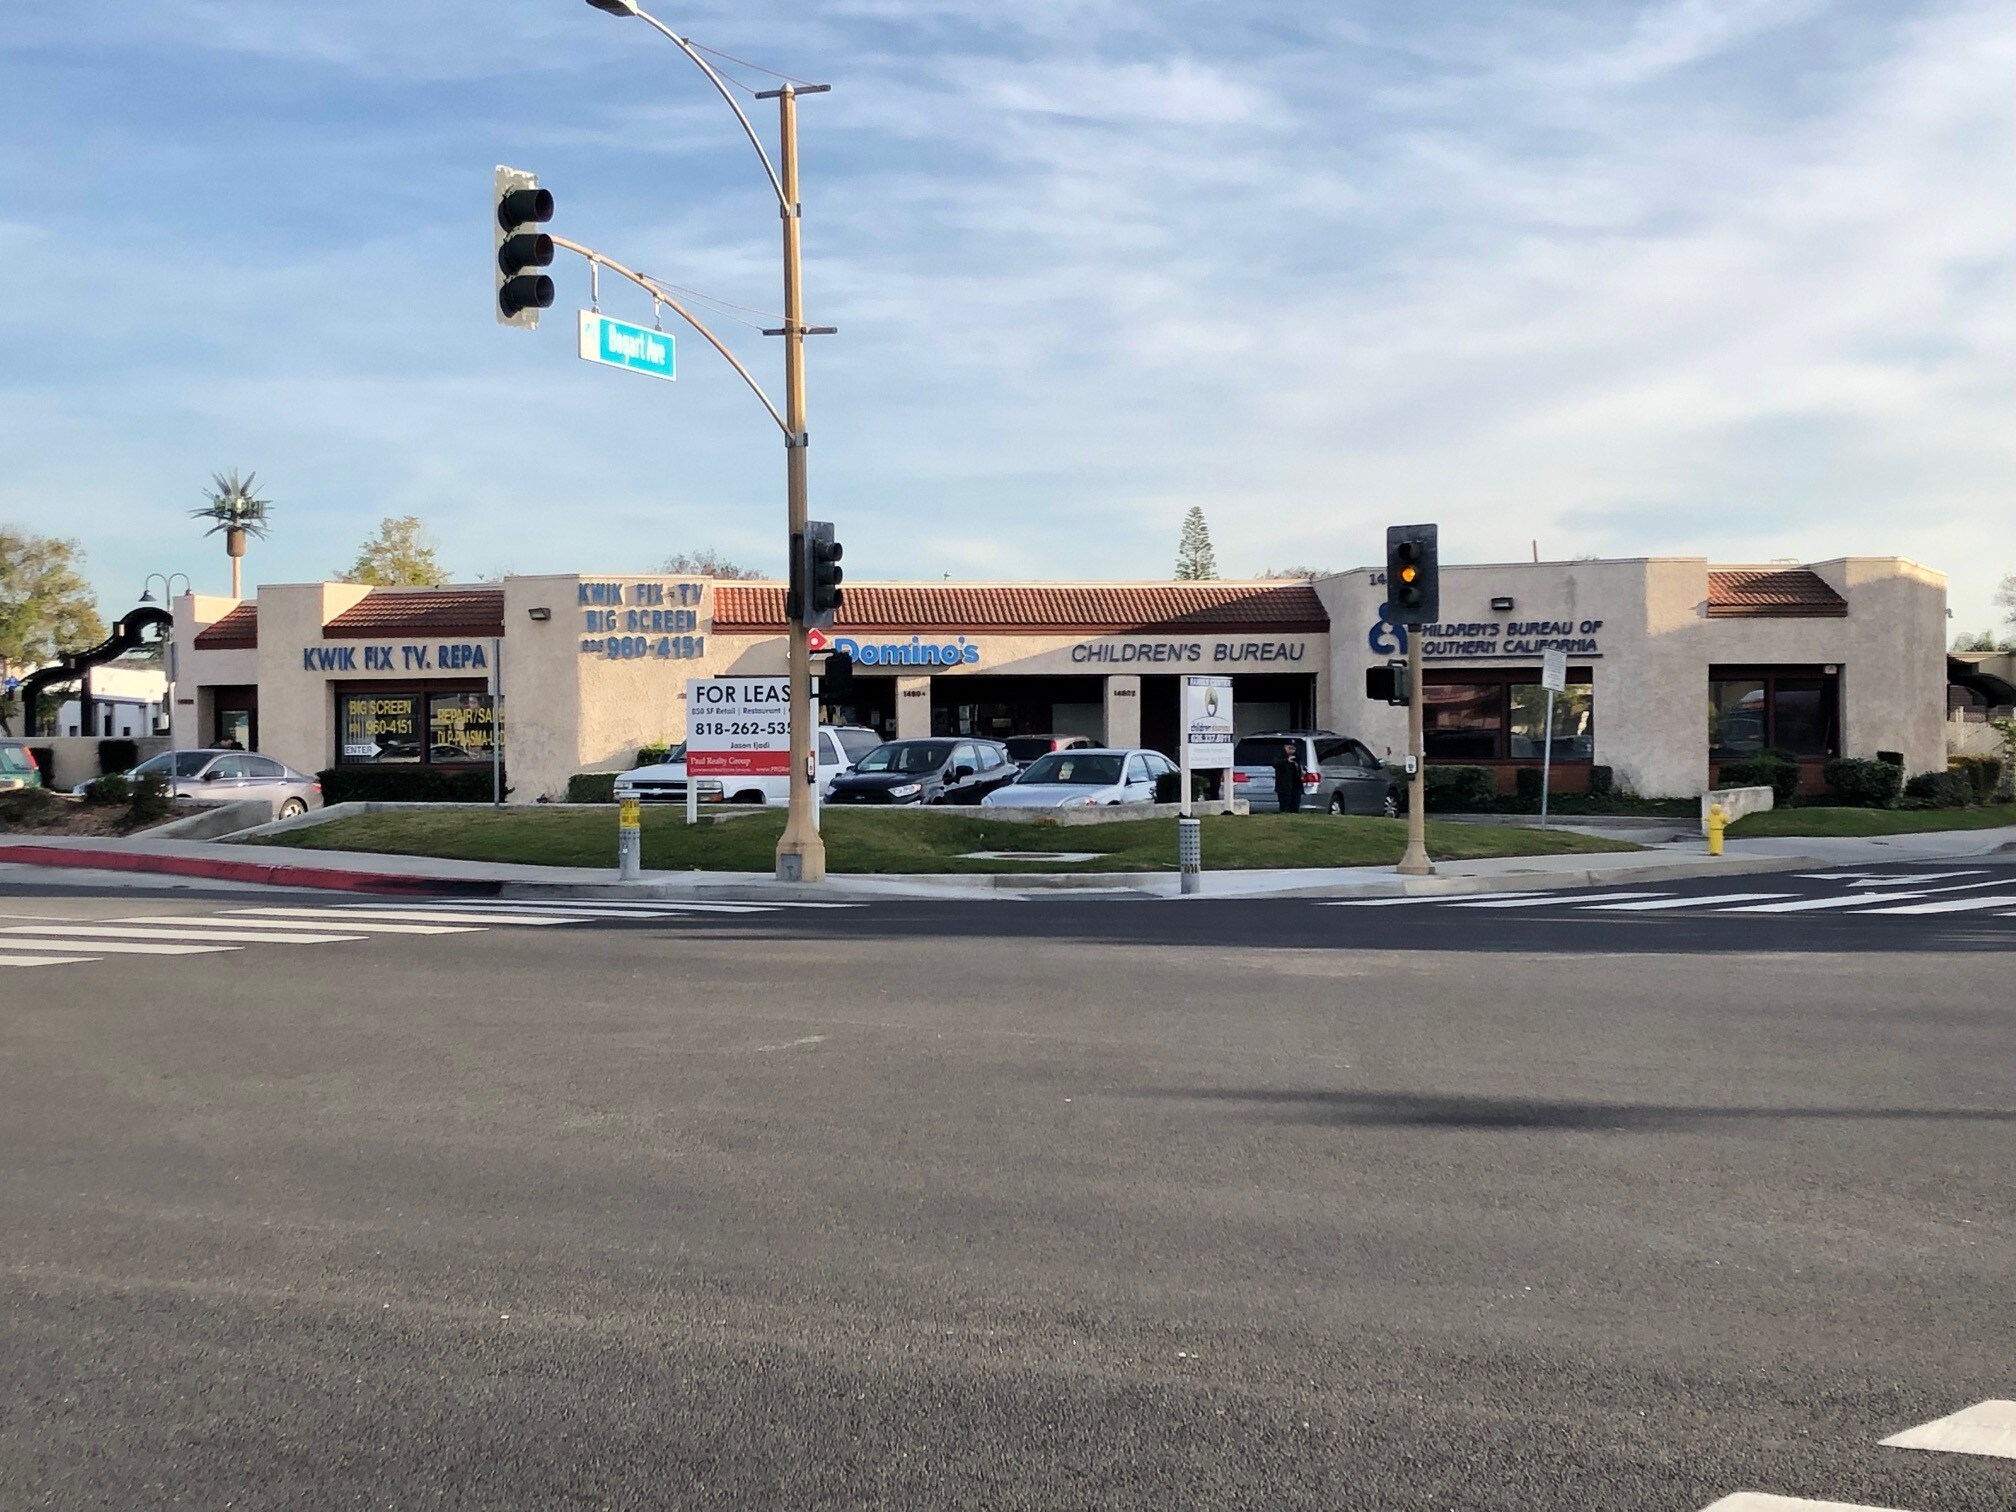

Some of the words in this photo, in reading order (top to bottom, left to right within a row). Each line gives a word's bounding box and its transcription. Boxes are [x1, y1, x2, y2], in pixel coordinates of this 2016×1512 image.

[607, 323, 645, 365] Bogart
[646, 333, 666, 366] Ave
[579, 583, 623, 606] KWIK
[586, 610, 616, 632] BIG
[627, 610, 696, 632] SCREEN
[1421, 623, 1499, 637] HILDREN'S
[1507, 621, 1573, 636] BUREAU
[1580, 620, 1603, 634] OF
[607, 636, 704, 659] 960-4151
[834, 636, 979, 665] Domino's
[1071, 643, 1201, 663] CHILDREN'S
[1213, 642, 1305, 662] BUREAU
[1503, 638, 1598, 653] CALIFORNIA
[303, 646, 357, 672] KWIK
[364, 646, 395, 671] FIX
[438, 644, 488, 669] REPA
[696, 685, 736, 703] FOR
[744, 685, 790, 702] LEAS
[349, 700, 367, 715] BIG
[369, 700, 412, 715] SCREEN
[366, 719, 412, 734] 960-4151
[695, 722, 790, 736] 818-262-53
[345, 746, 373, 754] ENTER
